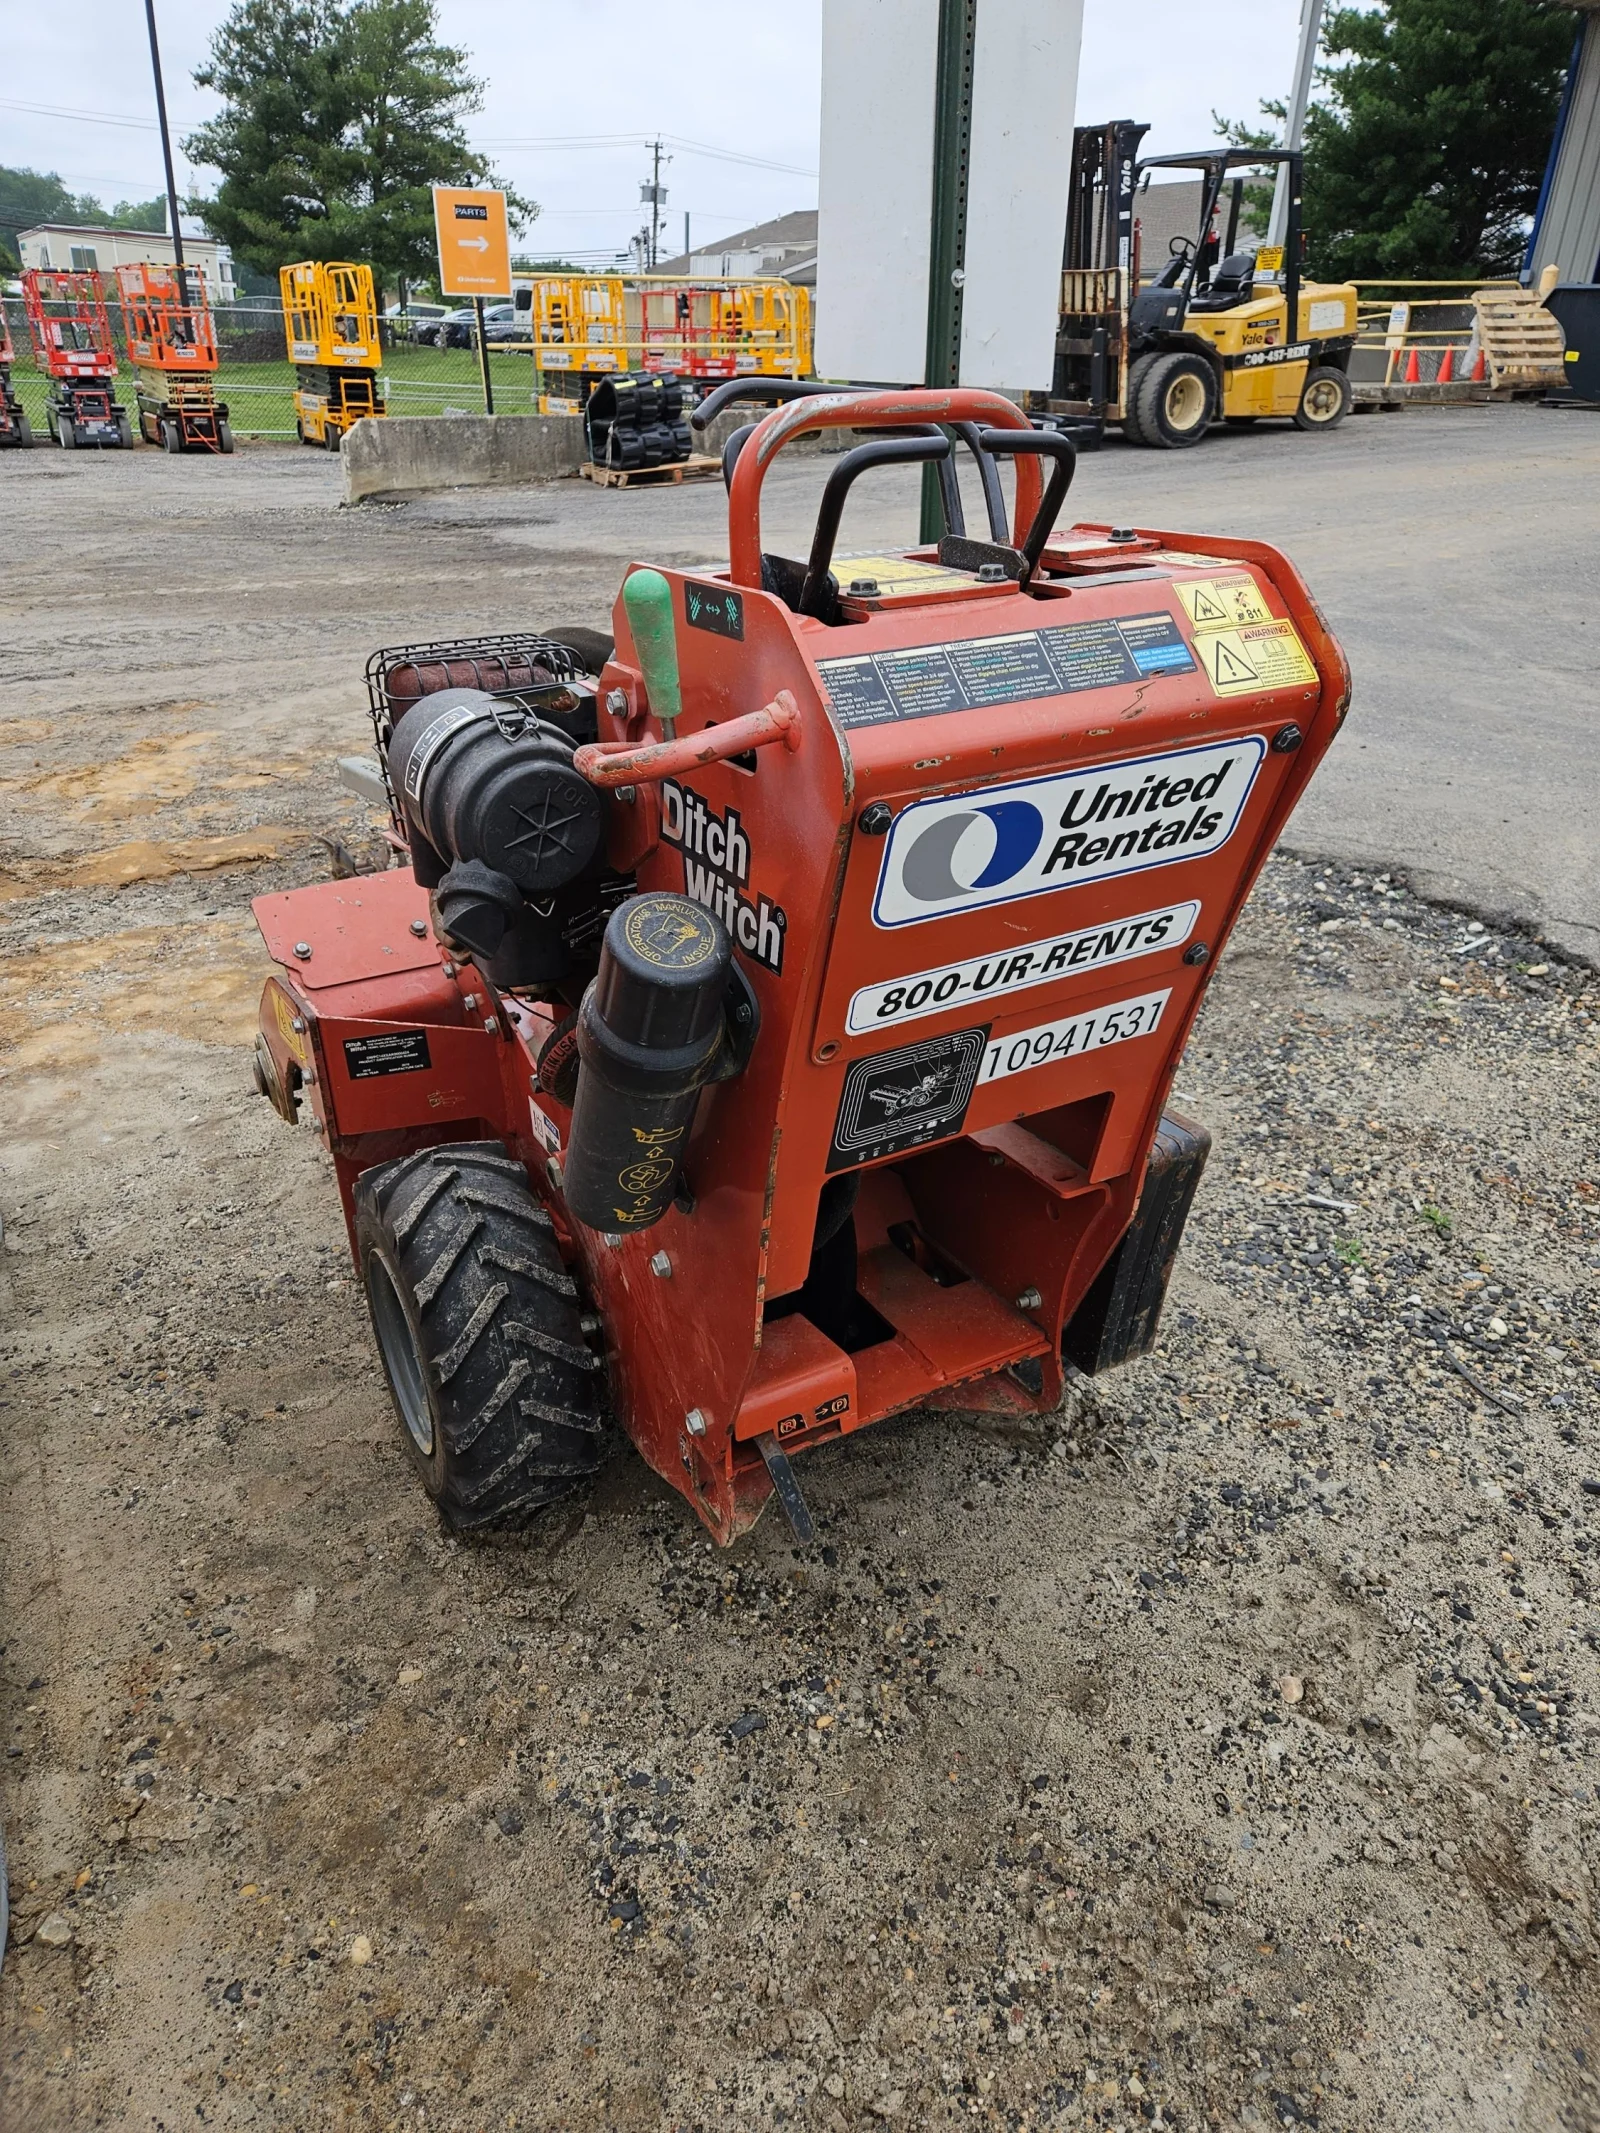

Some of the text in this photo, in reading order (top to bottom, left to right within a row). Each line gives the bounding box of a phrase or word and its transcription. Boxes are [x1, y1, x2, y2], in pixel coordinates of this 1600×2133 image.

[1120, 159, 1132, 196] Yale
[455, 206, 487, 217] PARTS
[1242, 332, 1263, 345] Yale
[1246, 607, 1264, 620] 811
[1250, 625, 1288, 639] WARNING
[554, 776, 588, 807] TOP
[1059, 758, 1235, 830] United
[662, 781, 748, 880] Ditch
[1040, 804, 1224, 876] Rentals
[654, 903, 700, 923] MANUAL
[682, 936, 711, 964] INSIDE
[685, 857, 781, 967] Witch
[876, 915, 1173, 1018] 800-UR-RENTS
[558, 1035, 577, 1058] USA
[988, 1000, 1163, 1078] 10941531
